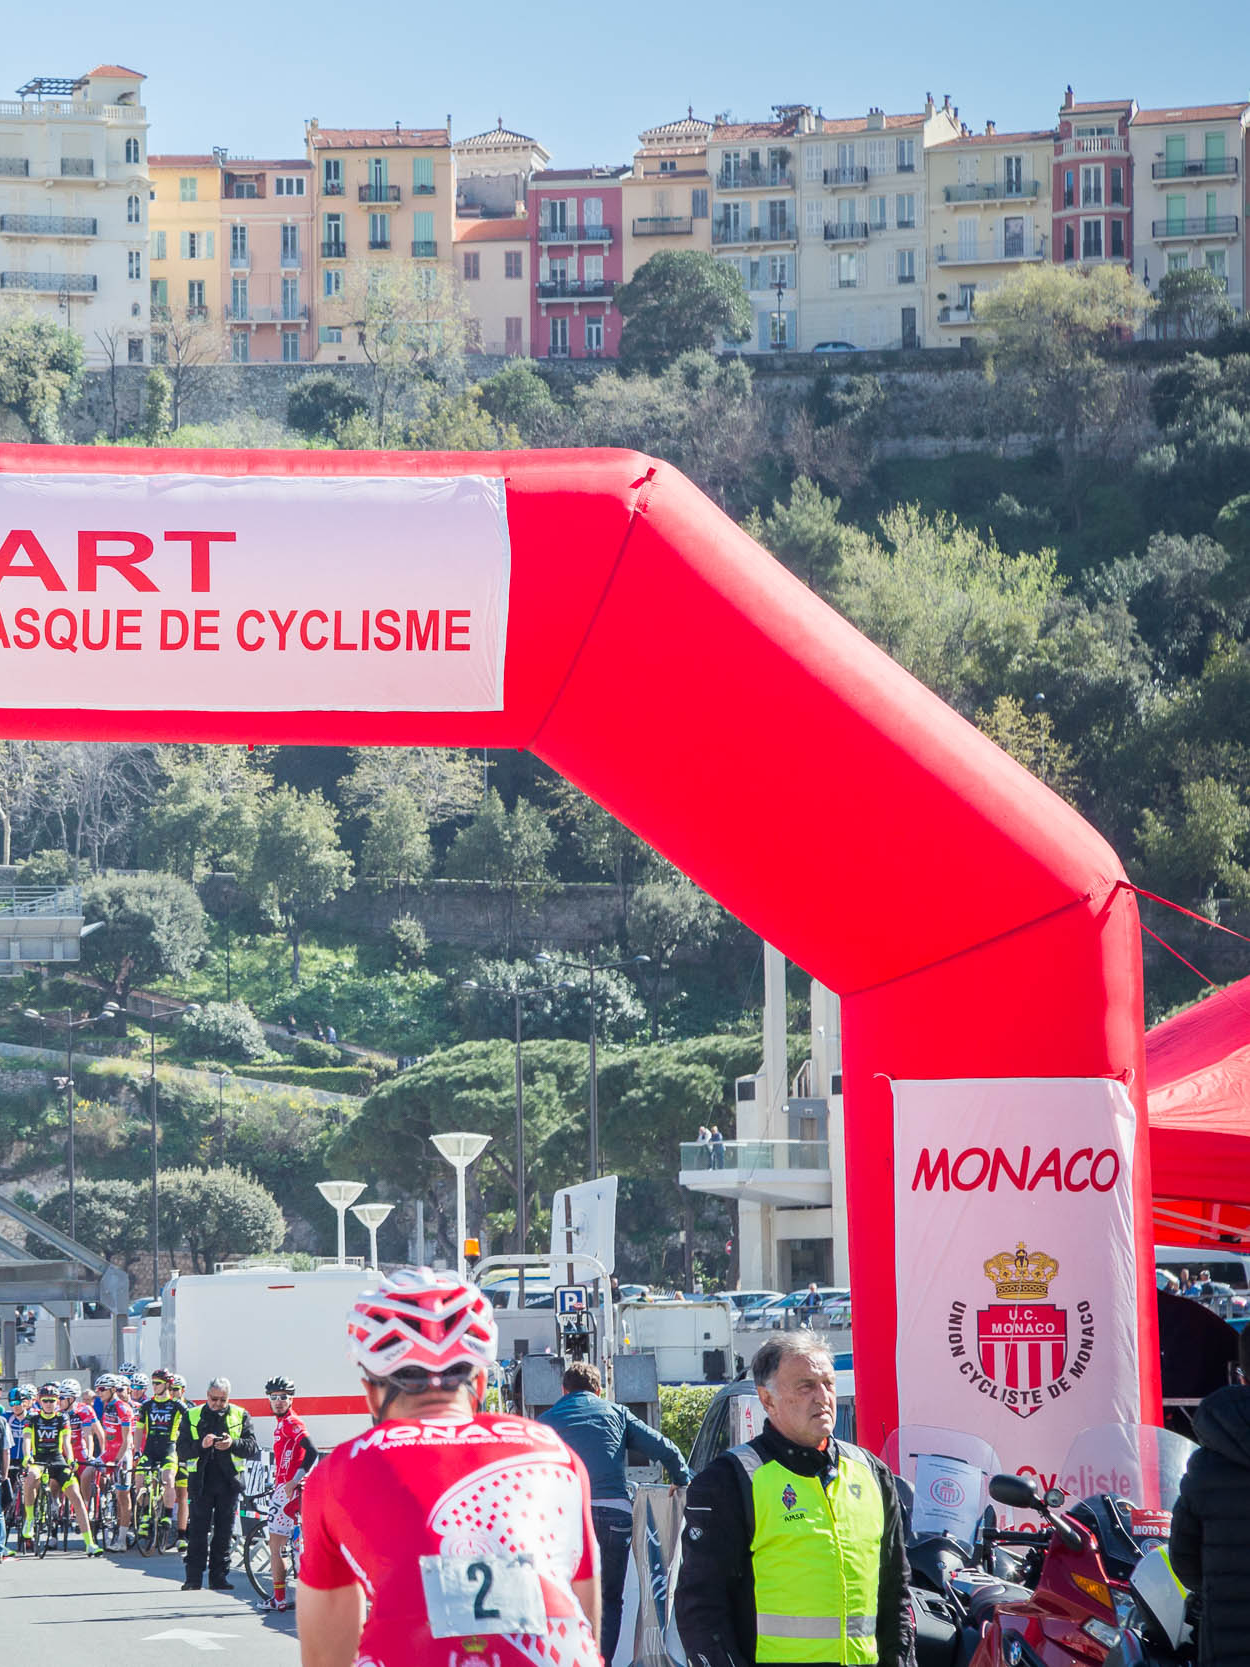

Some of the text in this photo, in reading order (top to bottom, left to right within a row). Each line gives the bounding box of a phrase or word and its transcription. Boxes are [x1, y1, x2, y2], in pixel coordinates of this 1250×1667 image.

[158, 608, 220, 652] DE
[236, 608, 471, 653] CYCLISME
[911, 1145, 1120, 1192] MONACO
[564, 1292, 578, 1312] P
[1008, 1309, 1038, 1321] U.C.
[991, 1322, 1055, 1334] MONACO
[948, 1300, 1095, 1405] UNION CYCLISTE DE MONACO
[350, 1421, 562, 1460] MONACO
[1133, 1525, 1160, 1535] MOTO
[466, 1561, 501, 1621] 2
